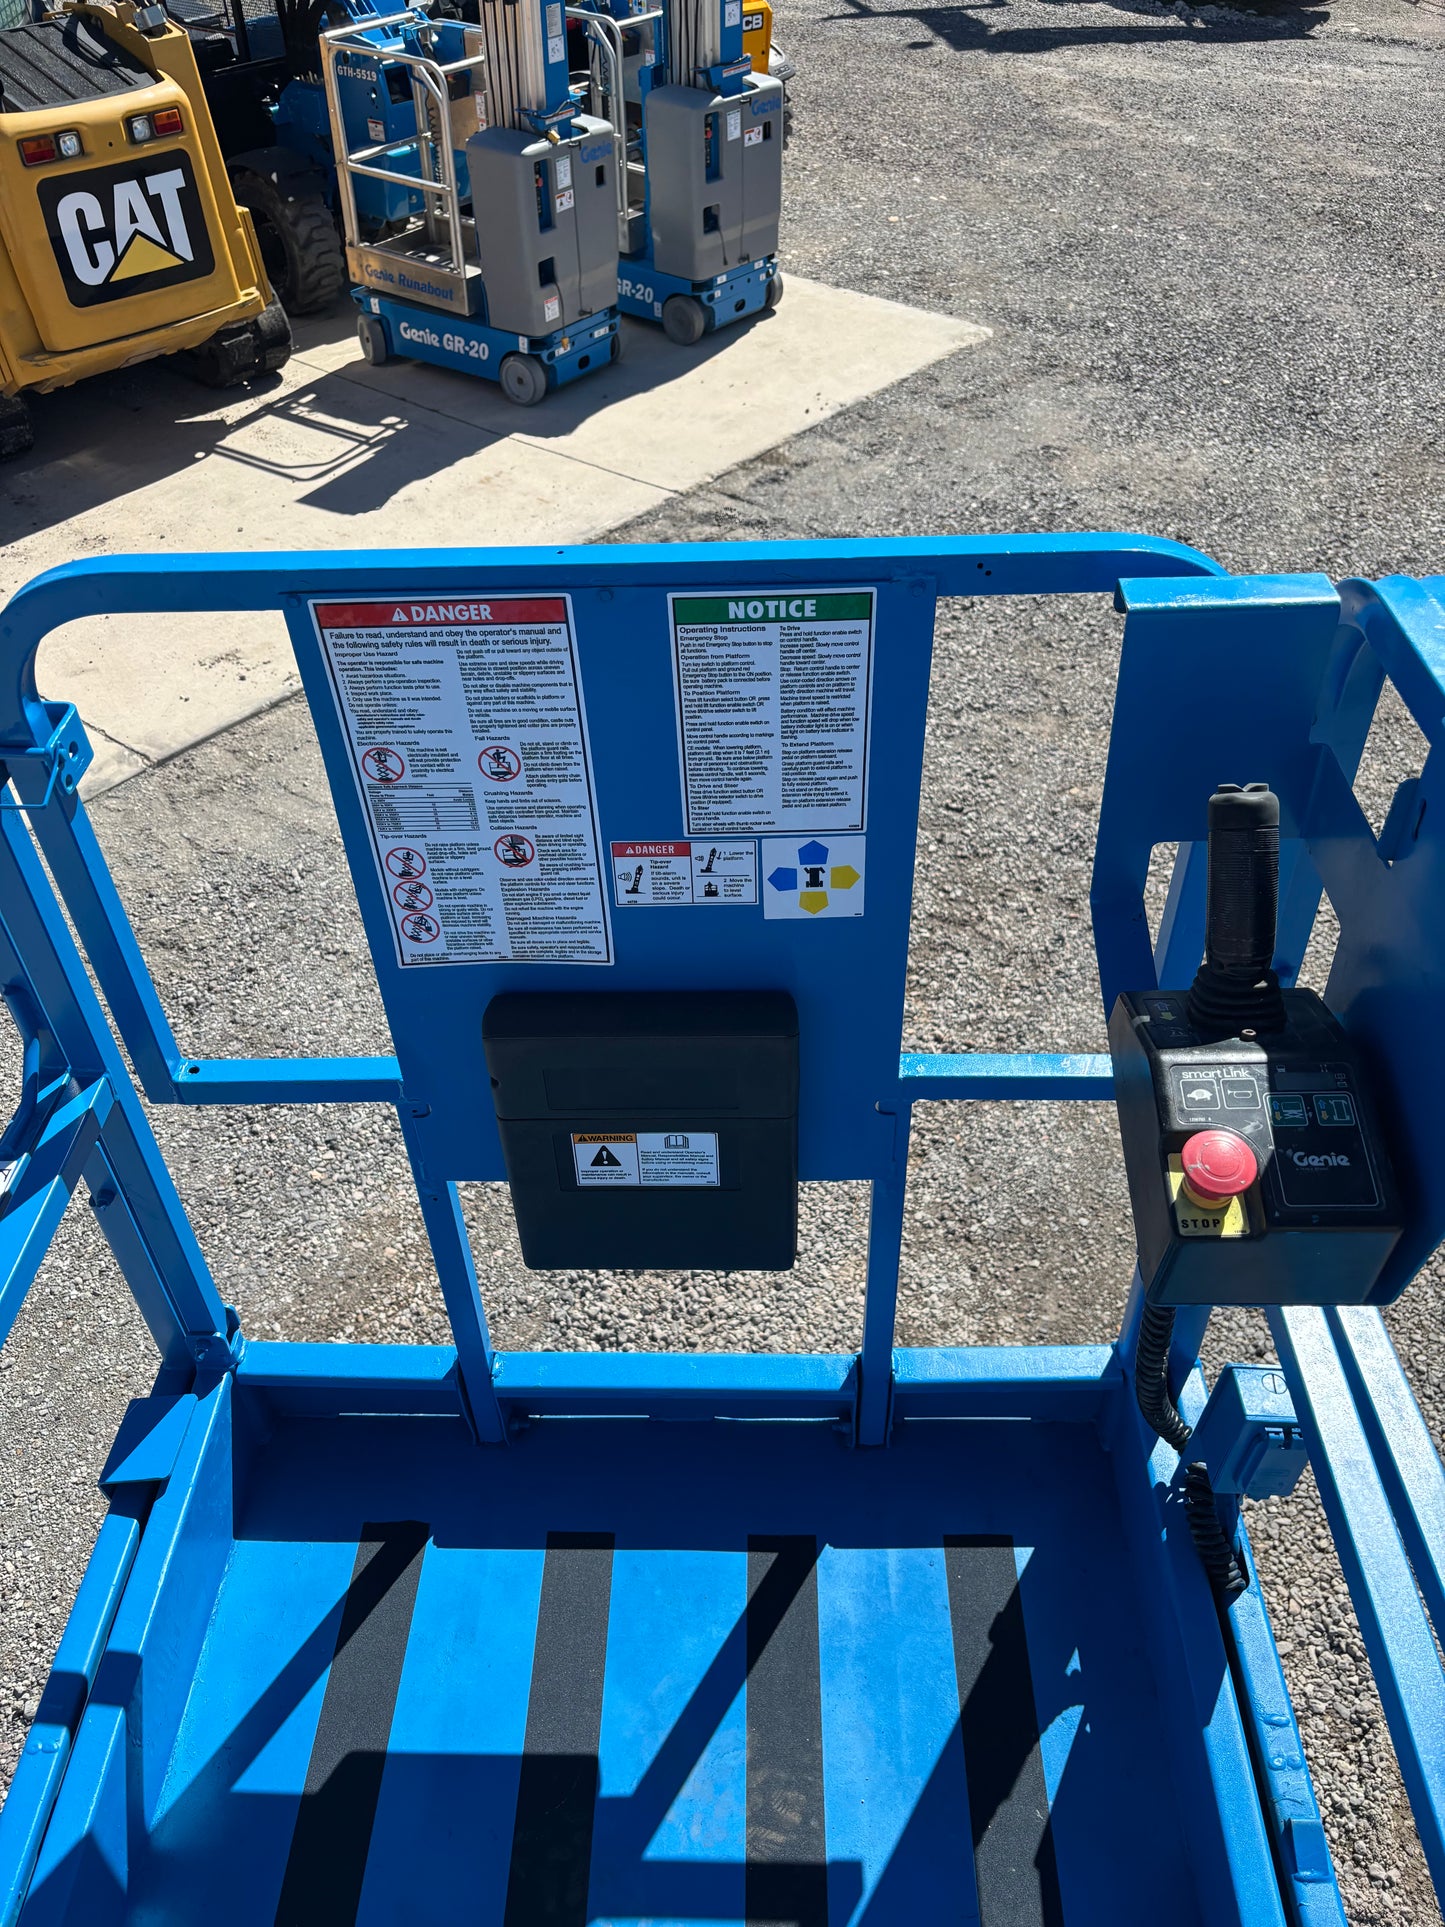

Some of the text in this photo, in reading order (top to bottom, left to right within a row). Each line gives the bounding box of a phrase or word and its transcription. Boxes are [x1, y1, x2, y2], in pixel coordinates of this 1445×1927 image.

[742, 15, 763, 31] CB
[337, 65, 377, 81] GTH-5519
[56, 168, 194, 286] CAT
[365, 264, 454, 301] Genie Runabout
[400, 322, 489, 361] Genie GR-20
[410, 604, 493, 622] DANGER
[728, 600, 816, 619] NOTICE
[329, 631, 354, 639] Failure
[679, 626, 717, 634] Operating
[345, 641, 379, 649] following
[635, 845, 674, 854] DANGER
[1293, 1152, 1350, 1167] Genie
[1181, 1218, 1220, 1229] STOP
